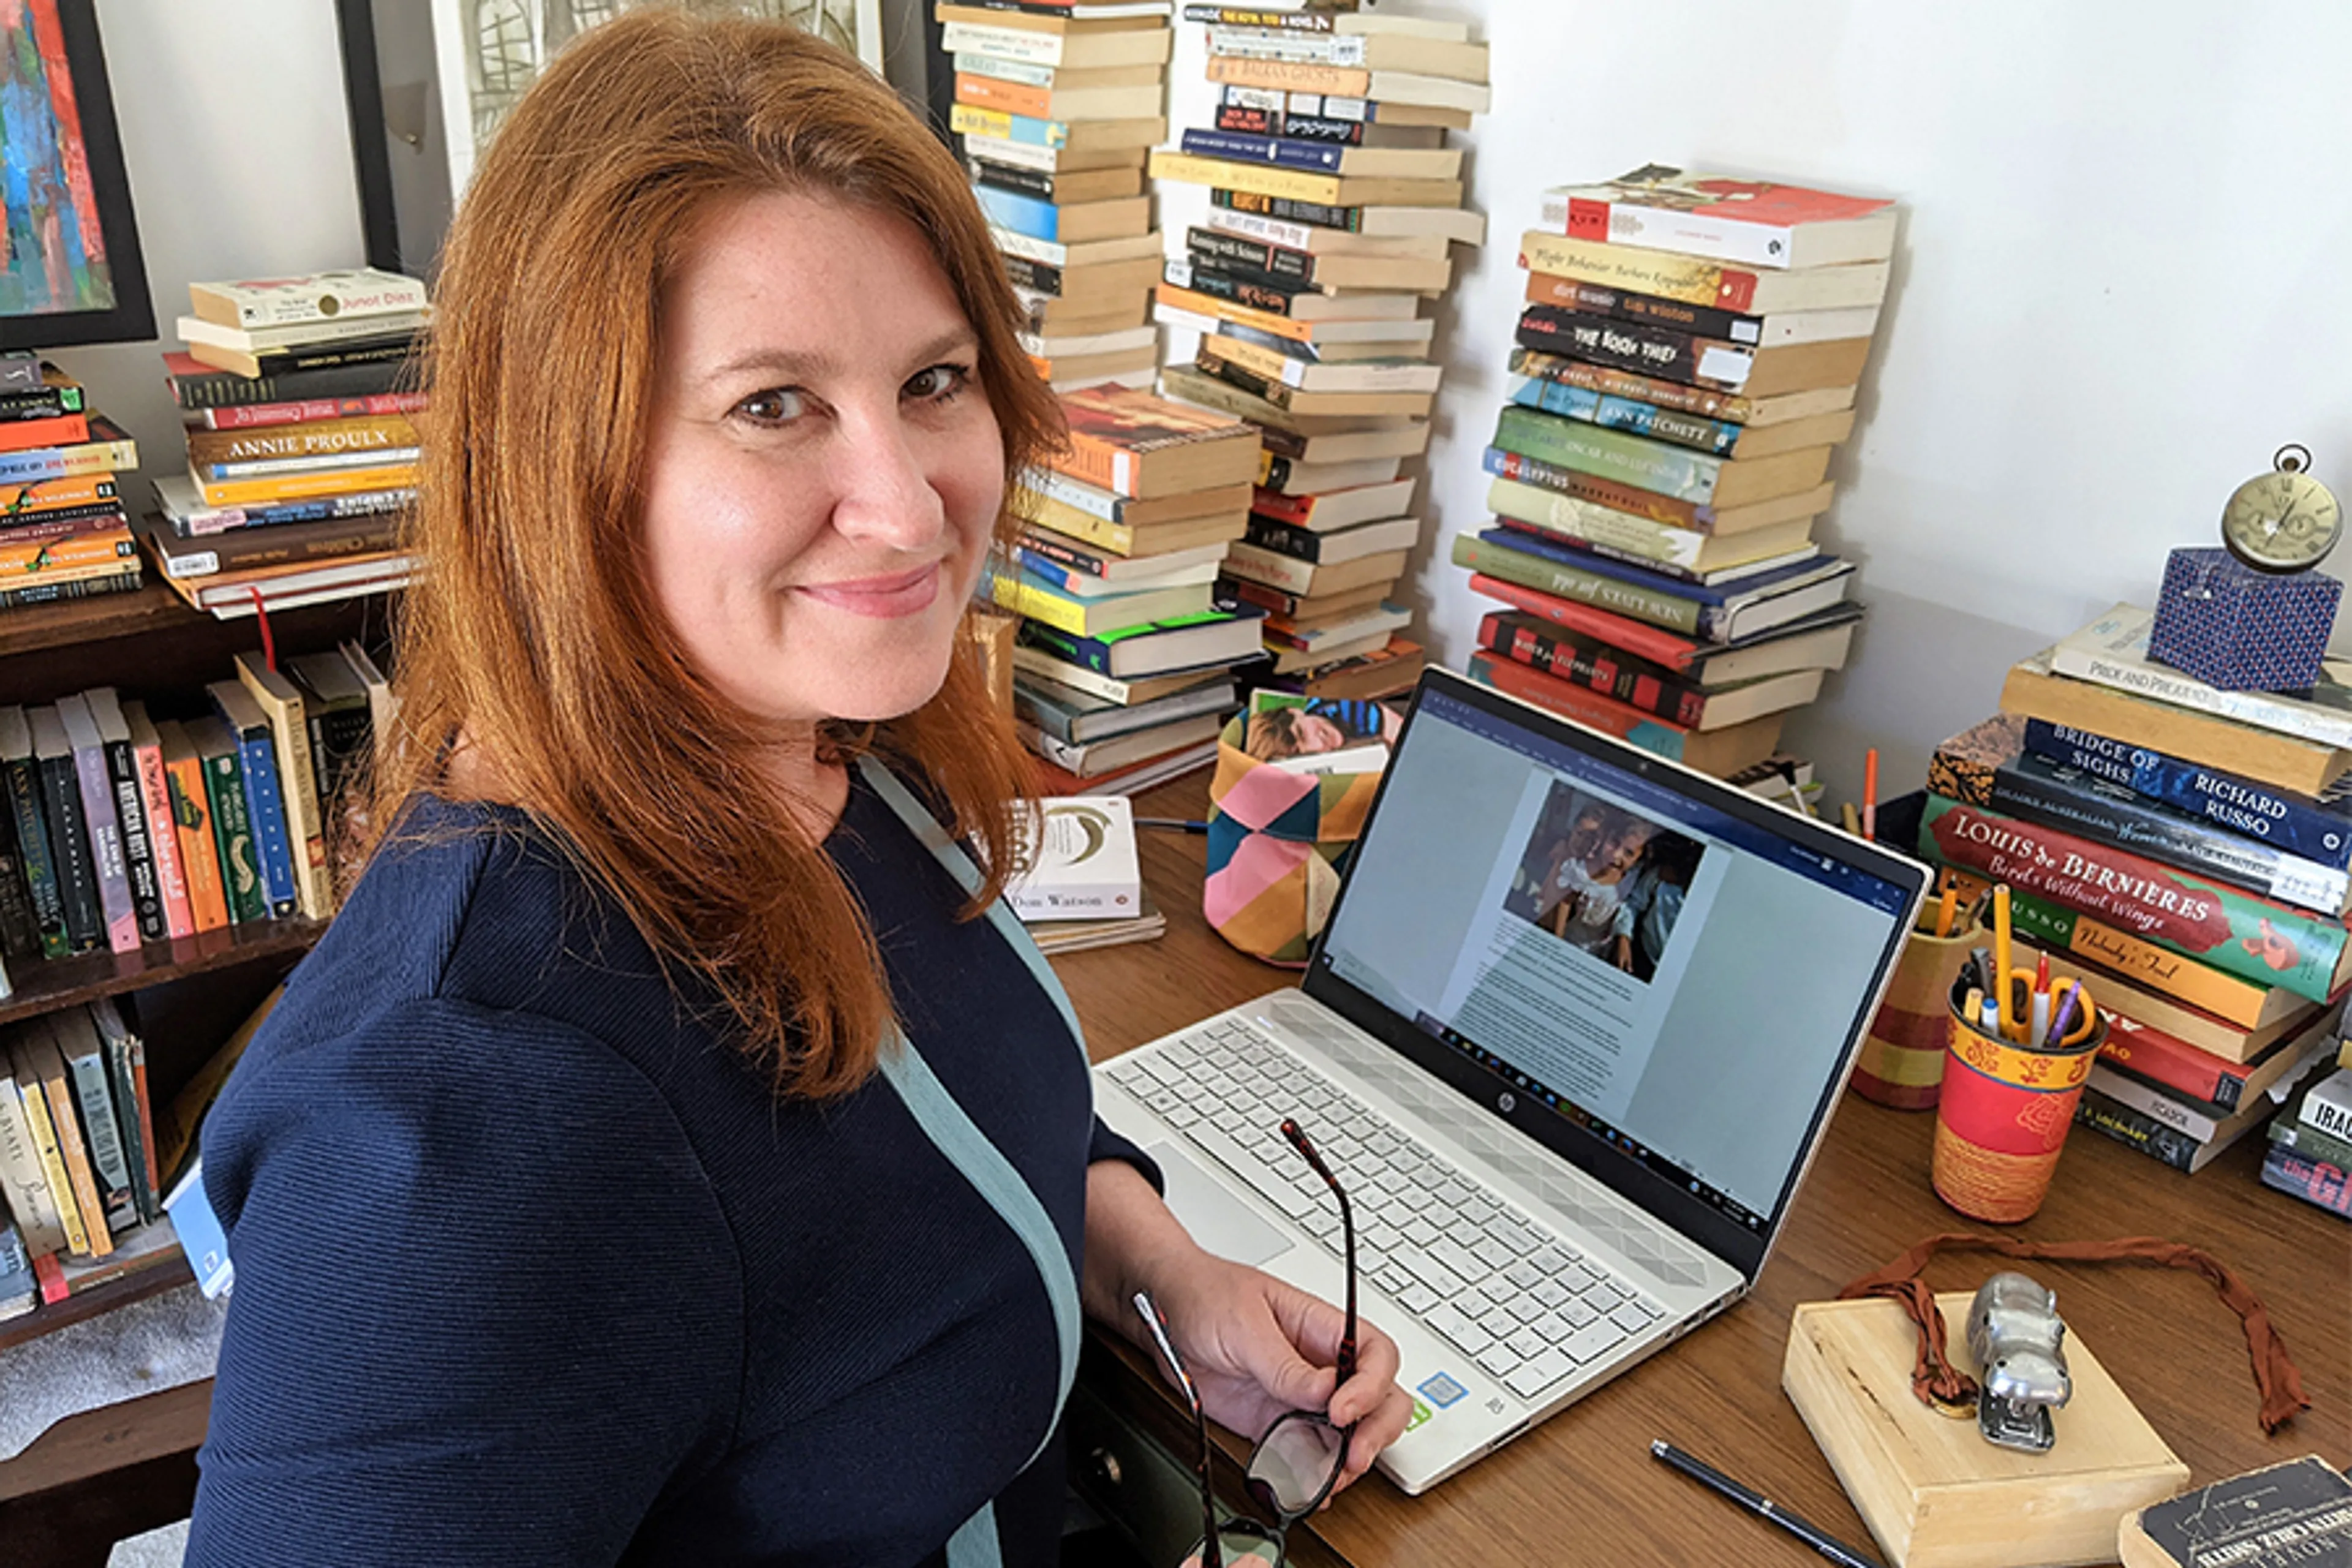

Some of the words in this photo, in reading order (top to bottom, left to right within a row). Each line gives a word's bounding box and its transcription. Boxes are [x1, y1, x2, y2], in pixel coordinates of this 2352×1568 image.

[1635, 411, 1708, 442] PATCHETT
[228, 436, 300, 458] ANNIE
[305, 429, 389, 452] PROULX
[1493, 457, 1570, 490] EUCALYPTUS
[2124, 670, 2150, 688] AND
[2053, 723, 2127, 760] BRIDGE
[2130, 750, 2160, 771] OF
[2072, 752, 2130, 783] SIGHS
[2195, 774, 2288, 820] RICHARD
[2205, 800, 2271, 837] RUSSO
[1954, 815, 2034, 857] LOUIS
[2034, 845, 2057, 869] de
[1048, 894, 1102, 907] Watson
[1988, 854, 2040, 885] Birds
[2044, 875, 2109, 909] Without
[2111, 899, 2165, 931] Wings
[2010, 900, 2070, 934] USSO
[2079, 925, 2136, 965] Nobody's
[2143, 949, 2180, 980] Fool
[2283, 1160, 2311, 1182] the
